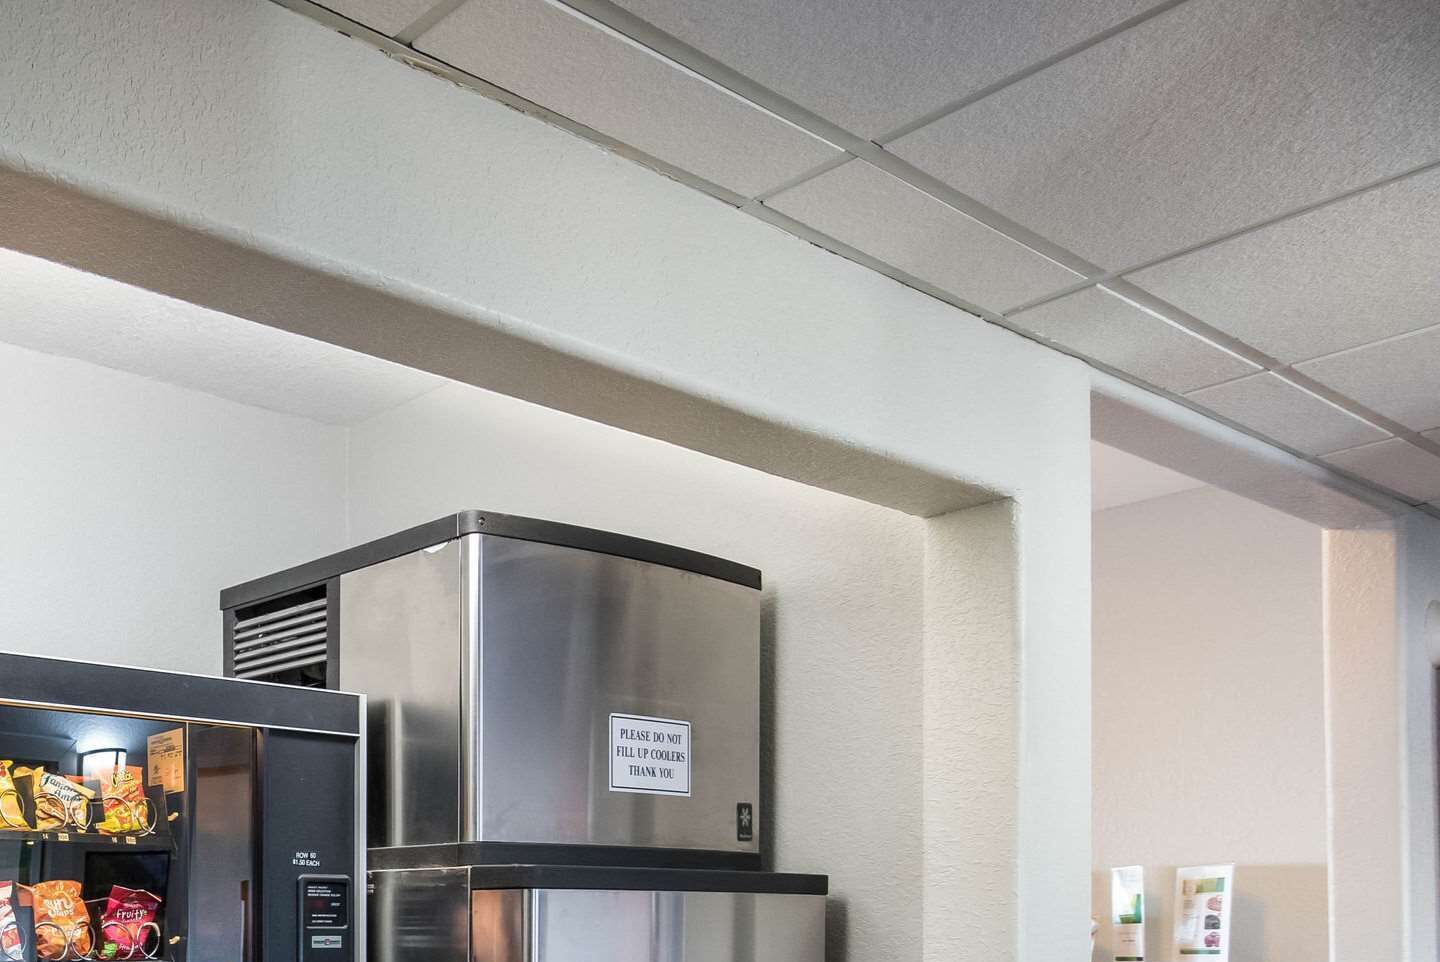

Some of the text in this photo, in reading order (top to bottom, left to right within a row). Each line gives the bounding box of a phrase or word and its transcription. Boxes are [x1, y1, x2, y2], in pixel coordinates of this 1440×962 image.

[620, 728, 682, 745] PLEASE DO NOT
[616, 746, 685, 762] FILL UP COOLERS
[629, 765, 674, 779] THANK YOU
[116, 909, 144, 920] Fruity
